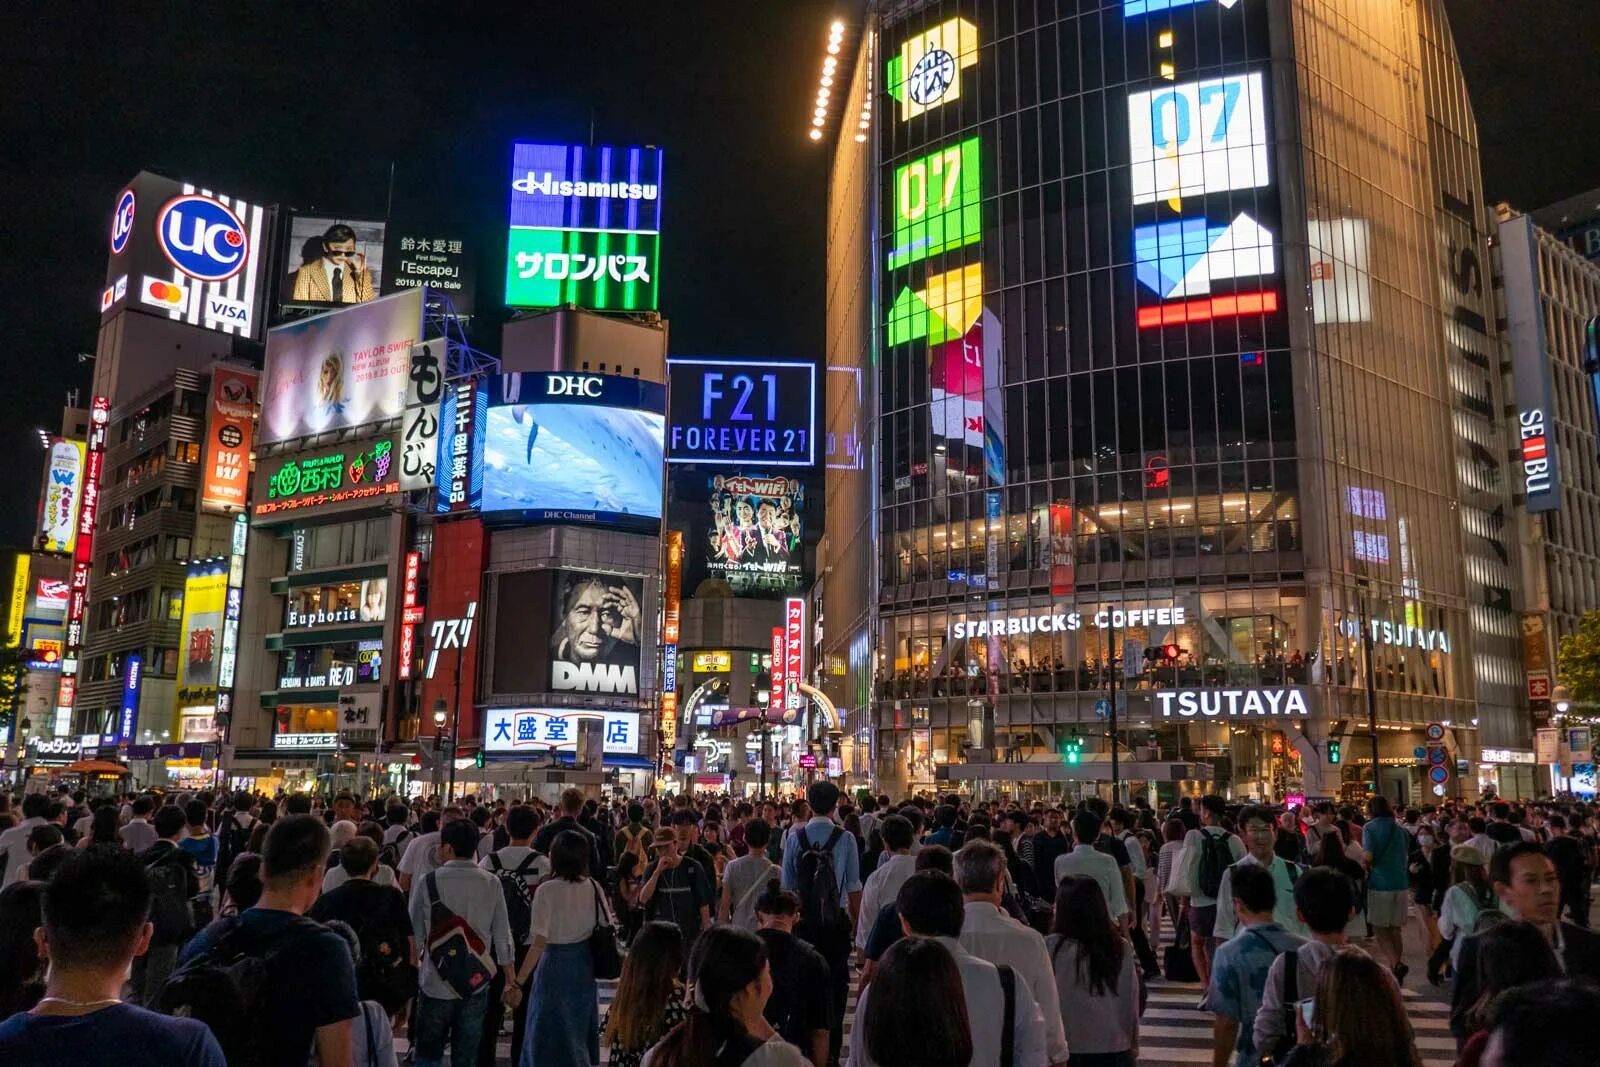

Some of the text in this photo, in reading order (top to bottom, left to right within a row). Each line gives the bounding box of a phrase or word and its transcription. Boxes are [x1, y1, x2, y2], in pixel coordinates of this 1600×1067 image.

[1152, 81, 1241, 150] 07
[512, 171, 658, 200] Hisamitsu
[900, 149, 960, 220] 07
[401, 237, 462, 254] 鈴木愛理
[415, 254, 447, 263] First Single
[515, 251, 650, 283] サロンパス
[430, 280, 443, 289] On
[443, 281, 462, 290] Sale
[211, 301, 248, 321] VISA
[353, 338, 415, 361] TAYLOR SWIFT
[352, 357, 390, 372] NEW ALBUM
[547, 375, 603, 397] DHC
[703, 373, 777, 421] F21
[403, 345, 442, 484] もんじゃ
[450, 385, 471, 503] 三千里薬品
[672, 426, 806, 453] FOREVER 21
[1519, 408, 1551, 494] SEIBU
[300, 464, 344, 493] 西村
[544, 511, 596, 521] DHC Channel
[289, 607, 356, 627] Euphoria
[953, 607, 1185, 639] STARBUCKS COFFEE
[426, 602, 477, 679] クスリ
[789, 607, 801, 665] カラオケ
[1372, 618, 1451, 653] TSUTAYA
[552, 660, 637, 694] DMM
[1156, 689, 1309, 717] TSUTAYA
[493, 716, 629, 744] 大盛堂店
